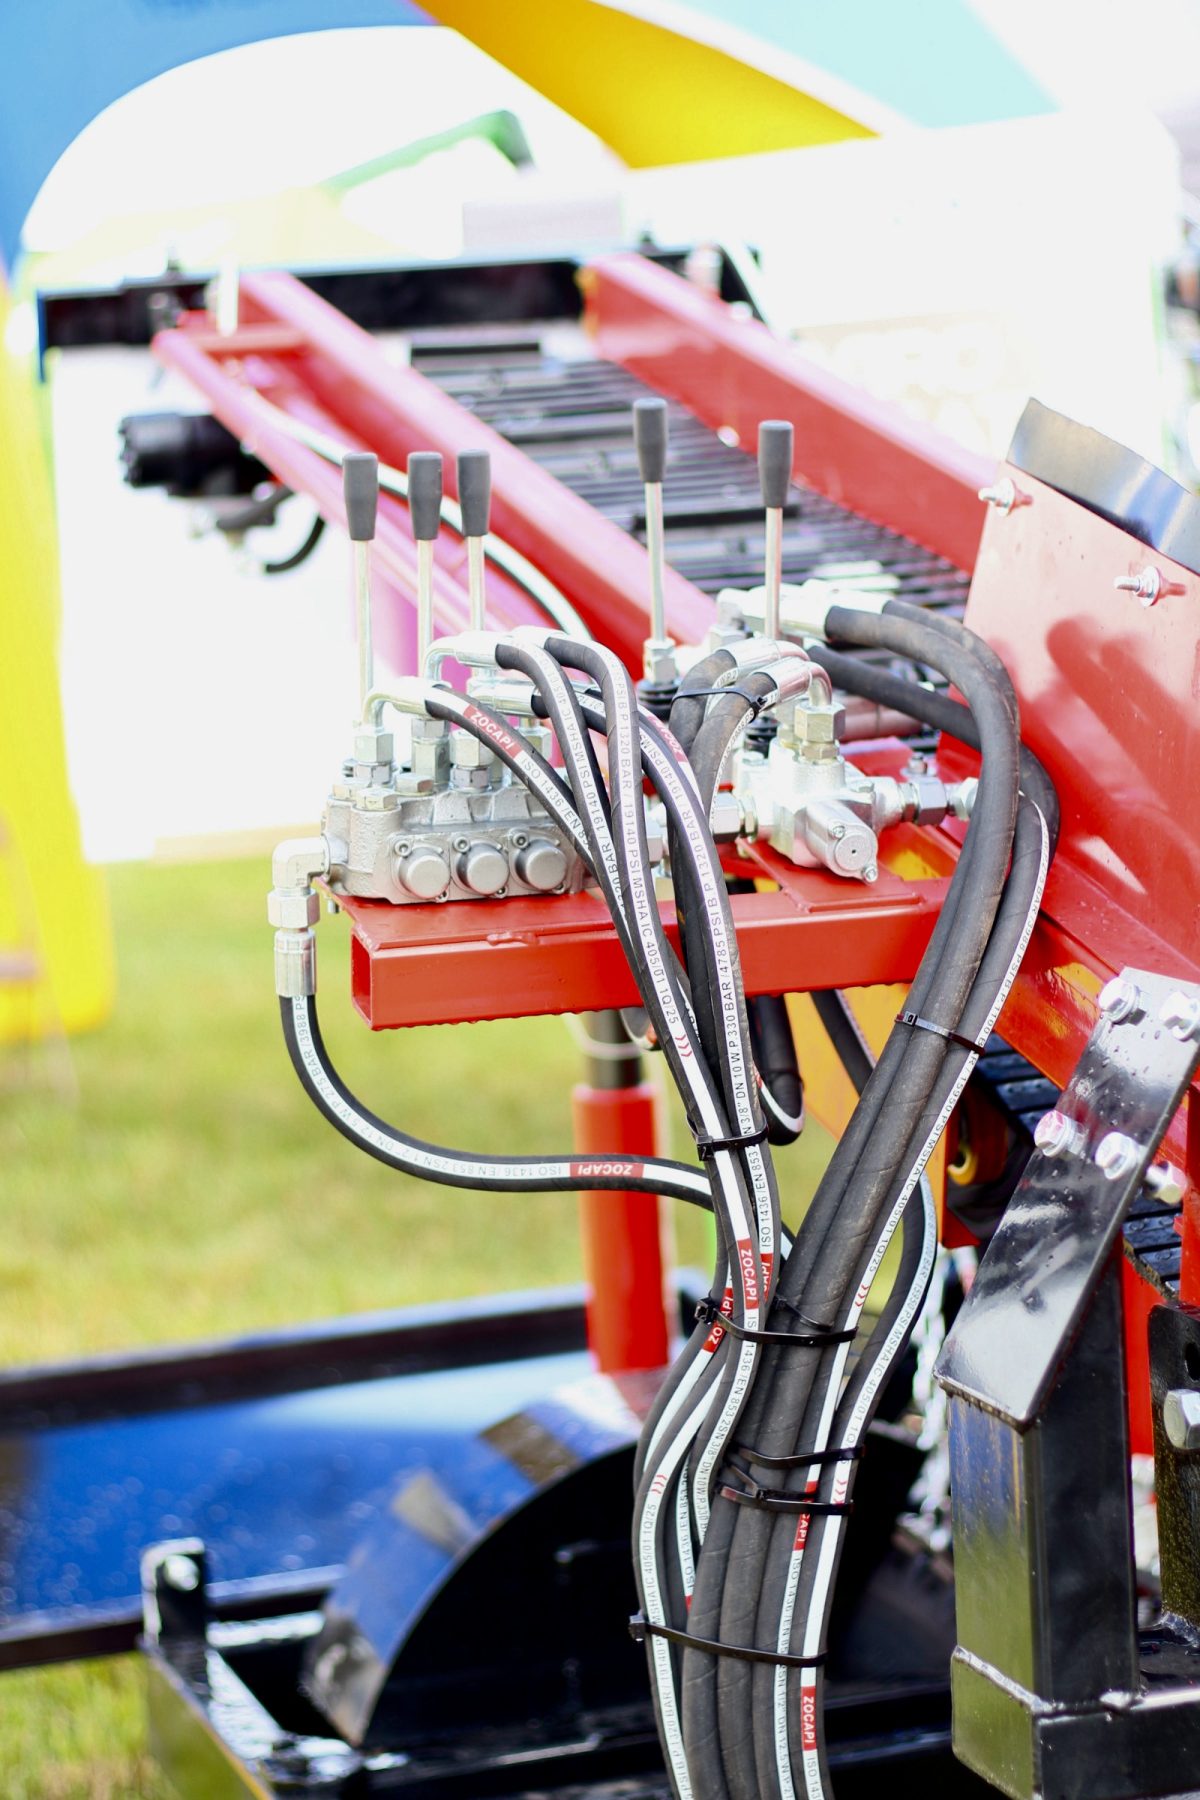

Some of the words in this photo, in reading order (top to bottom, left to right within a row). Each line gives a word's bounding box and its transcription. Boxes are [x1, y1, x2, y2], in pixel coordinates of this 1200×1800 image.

[559, 705, 573, 722] IC
[565, 721, 585, 762] MSHA
[469, 709, 515, 751] ZOCAPI
[519, 756, 542, 780] ISO
[538, 779, 564, 808] 1436
[646, 746, 665, 767] PSI
[577, 765, 593, 789] PSI
[620, 757, 632, 789] BAR
[659, 764, 683, 800] 19140
[585, 790, 606, 831] 19140
[623, 803, 637, 845] 19140
[679, 808, 701, 841] BAR
[600, 841, 619, 875] BAR
[627, 849, 641, 874] PSI
[631, 876, 649, 920] MSHA
[640, 922, 653, 938] IC
[709, 910, 723, 936] PSI
[643, 940, 666, 985] 405/01
[1008, 952, 1022, 976] PSI
[658, 987, 680, 1026] 1Q/25
[720, 980, 734, 1011] BAR
[303, 1047, 322, 1077] BAR
[967, 1036, 986, 1066] BR
[730, 1064, 743, 1079] 10
[733, 1080, 746, 1098] DN
[943, 1074, 967, 1113] 15950
[737, 1100, 750, 1124] 3/8"
[931, 1114, 947, 1137] PSI
[374, 1134, 395, 1151] DN
[422, 1154, 450, 1170] 2SN
[452, 1161, 475, 1175] 853
[577, 1163, 632, 1175] ZOCAPI
[748, 1150, 761, 1171] 853
[911, 1137, 936, 1176] MSHA
[504, 1166, 533, 1176] 1436
[538, 1165, 561, 1175] ISO
[905, 1177, 916, 1192] IC
[756, 1195, 770, 1222] 1436
[884, 1192, 909, 1234] 405/01
[760, 1225, 771, 1247] ISO
[740, 1247, 757, 1301] ZOCAPI
[707, 1295, 734, 1345] ZOAPI
[746, 1316, 756, 1329] IS
[897, 1309, 912, 1329] PSI
[739, 1342, 755, 1373] 1436
[879, 1328, 903, 1364] MSHA
[871, 1361, 886, 1378] IC
[724, 1396, 740, 1420] 853
[713, 1418, 731, 1441] 2SN
[642, 1502, 657, 1535] 1Q/25
[796, 1512, 810, 1542] CAPI
[642, 1538, 653, 1574] 405/01
[789, 1556, 801, 1580] ISO
[644, 1576, 655, 1588] IC
[684, 1565, 695, 1588] ISO
[645, 1589, 662, 1623] MSHA
[803, 1695, 815, 1744] ZOCAPI
[805, 1757, 817, 1777] ISO
[808, 1780, 821, 1798] 143
